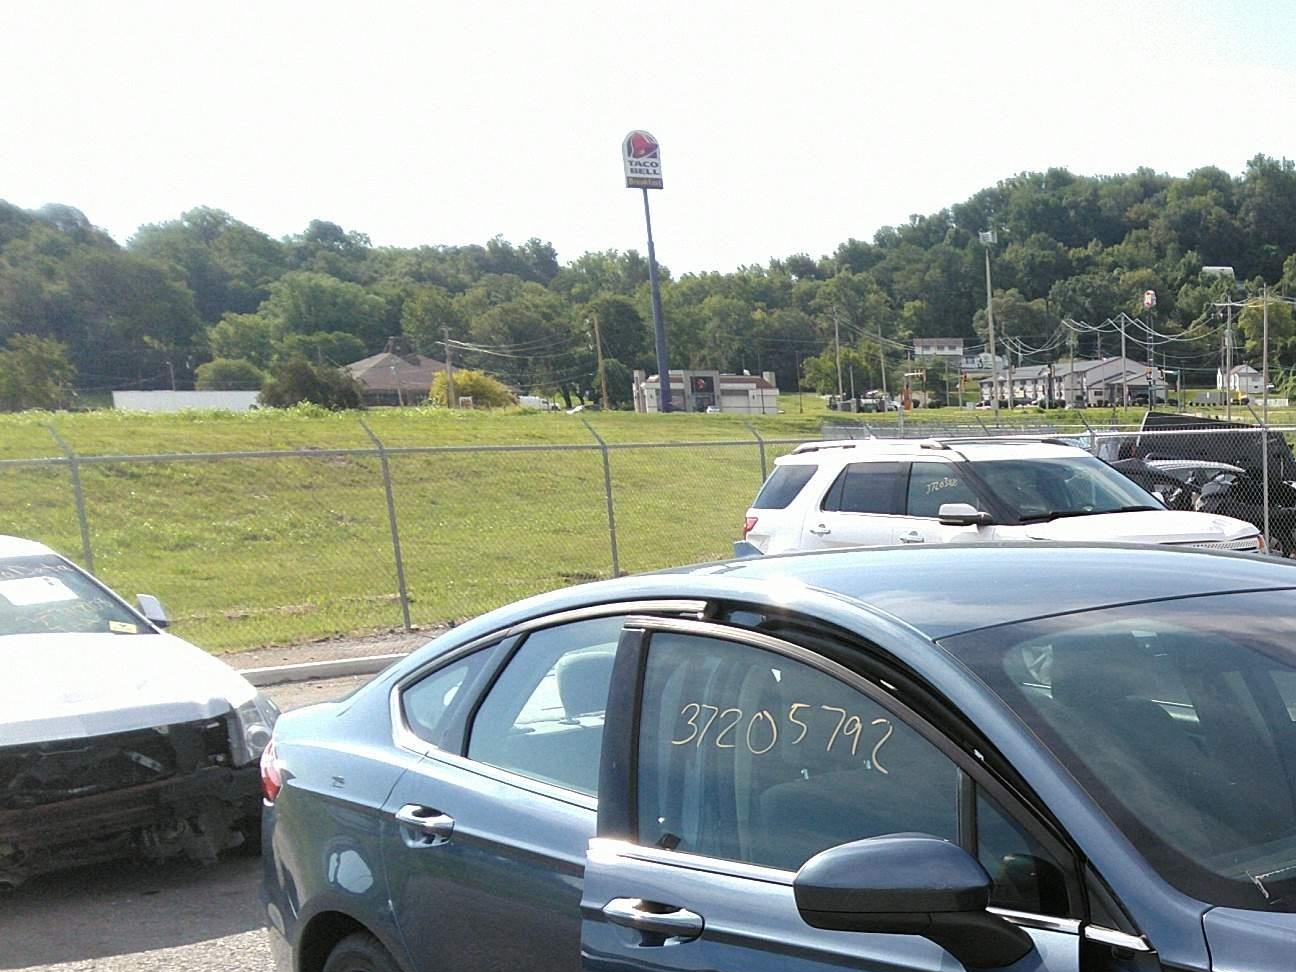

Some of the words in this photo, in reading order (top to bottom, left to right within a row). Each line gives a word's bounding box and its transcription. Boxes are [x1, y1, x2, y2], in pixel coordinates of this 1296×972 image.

[628, 160, 659, 168] TACO
[629, 167, 660, 176] BELL
[671, 702, 894, 775] 37205792
